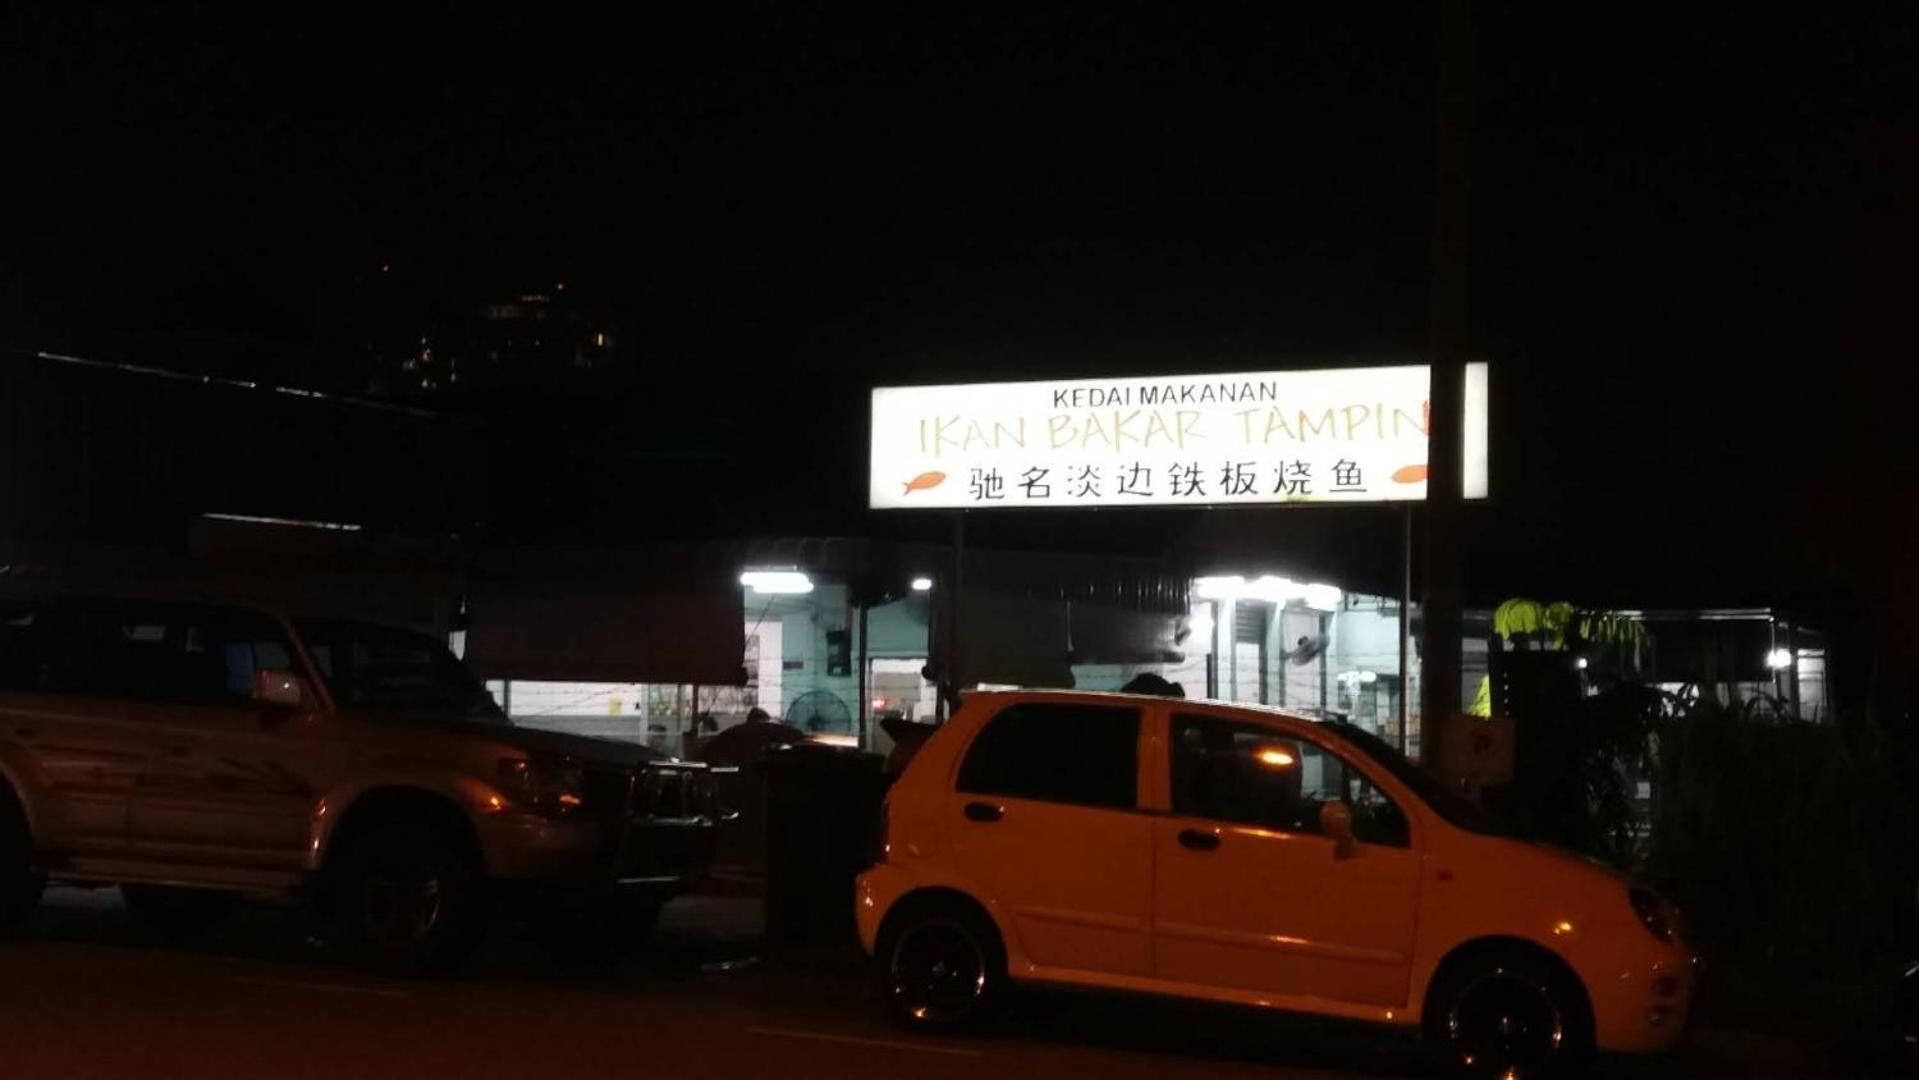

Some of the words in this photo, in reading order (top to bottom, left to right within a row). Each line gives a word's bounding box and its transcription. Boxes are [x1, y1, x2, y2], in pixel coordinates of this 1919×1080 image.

[1053, 387, 1131, 408] KEDAI
[1140, 381, 1277, 405] MAKANAN
[920, 415, 1025, 456] IKAN
[1047, 410, 1206, 452] BAKAR
[1234, 400, 1431, 443] TAMPIN
[968, 459, 1368, 500] 驰名淡边铁板烧鱼
